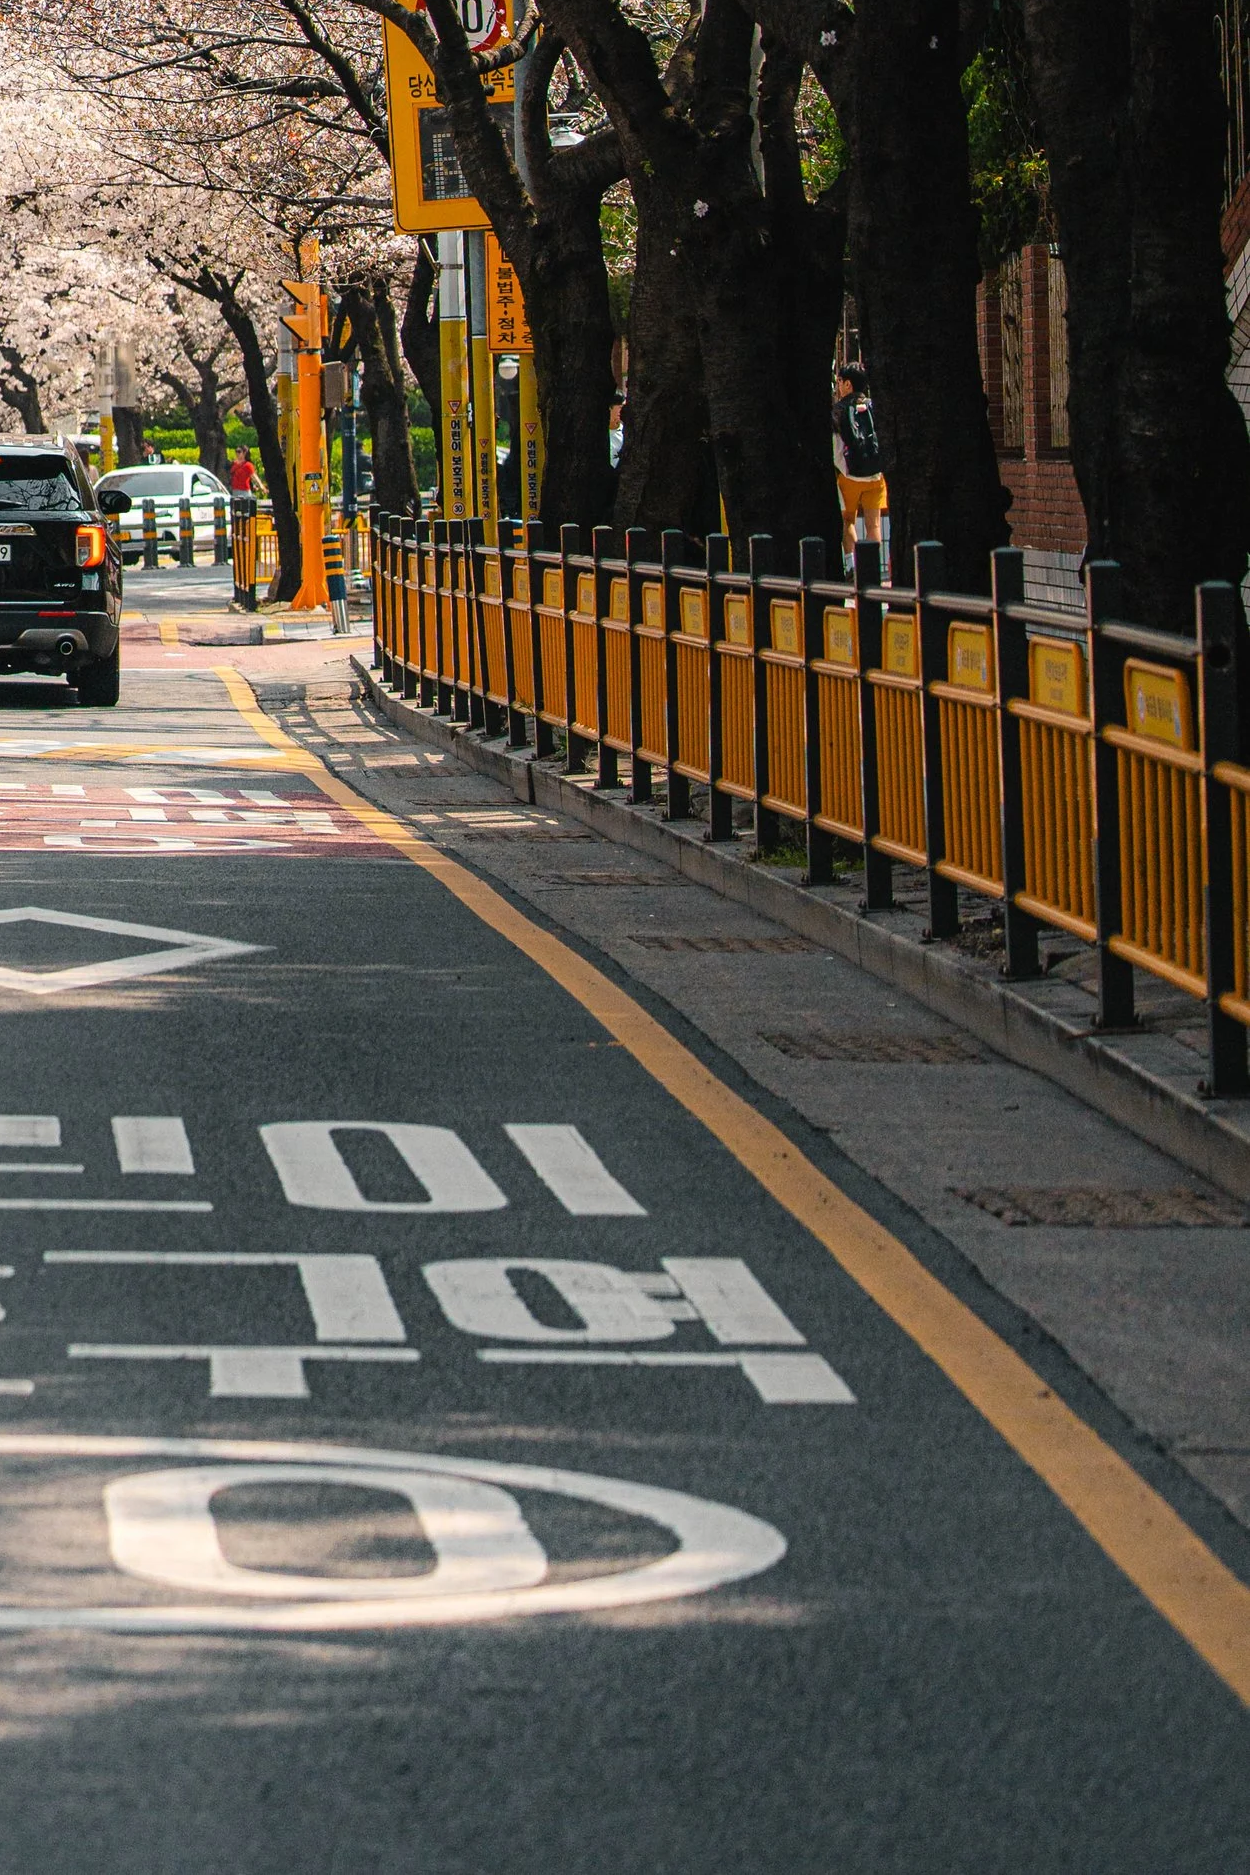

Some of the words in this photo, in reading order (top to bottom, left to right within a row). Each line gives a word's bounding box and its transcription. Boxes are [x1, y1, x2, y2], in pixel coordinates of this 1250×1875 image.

[451, 419, 462, 452] 어린이
[527, 439, 537, 469] 어린이
[452, 455, 463, 498] 보호구역
[528, 472, 538, 511] 보호구역
[454, 505, 463, 513] 30
